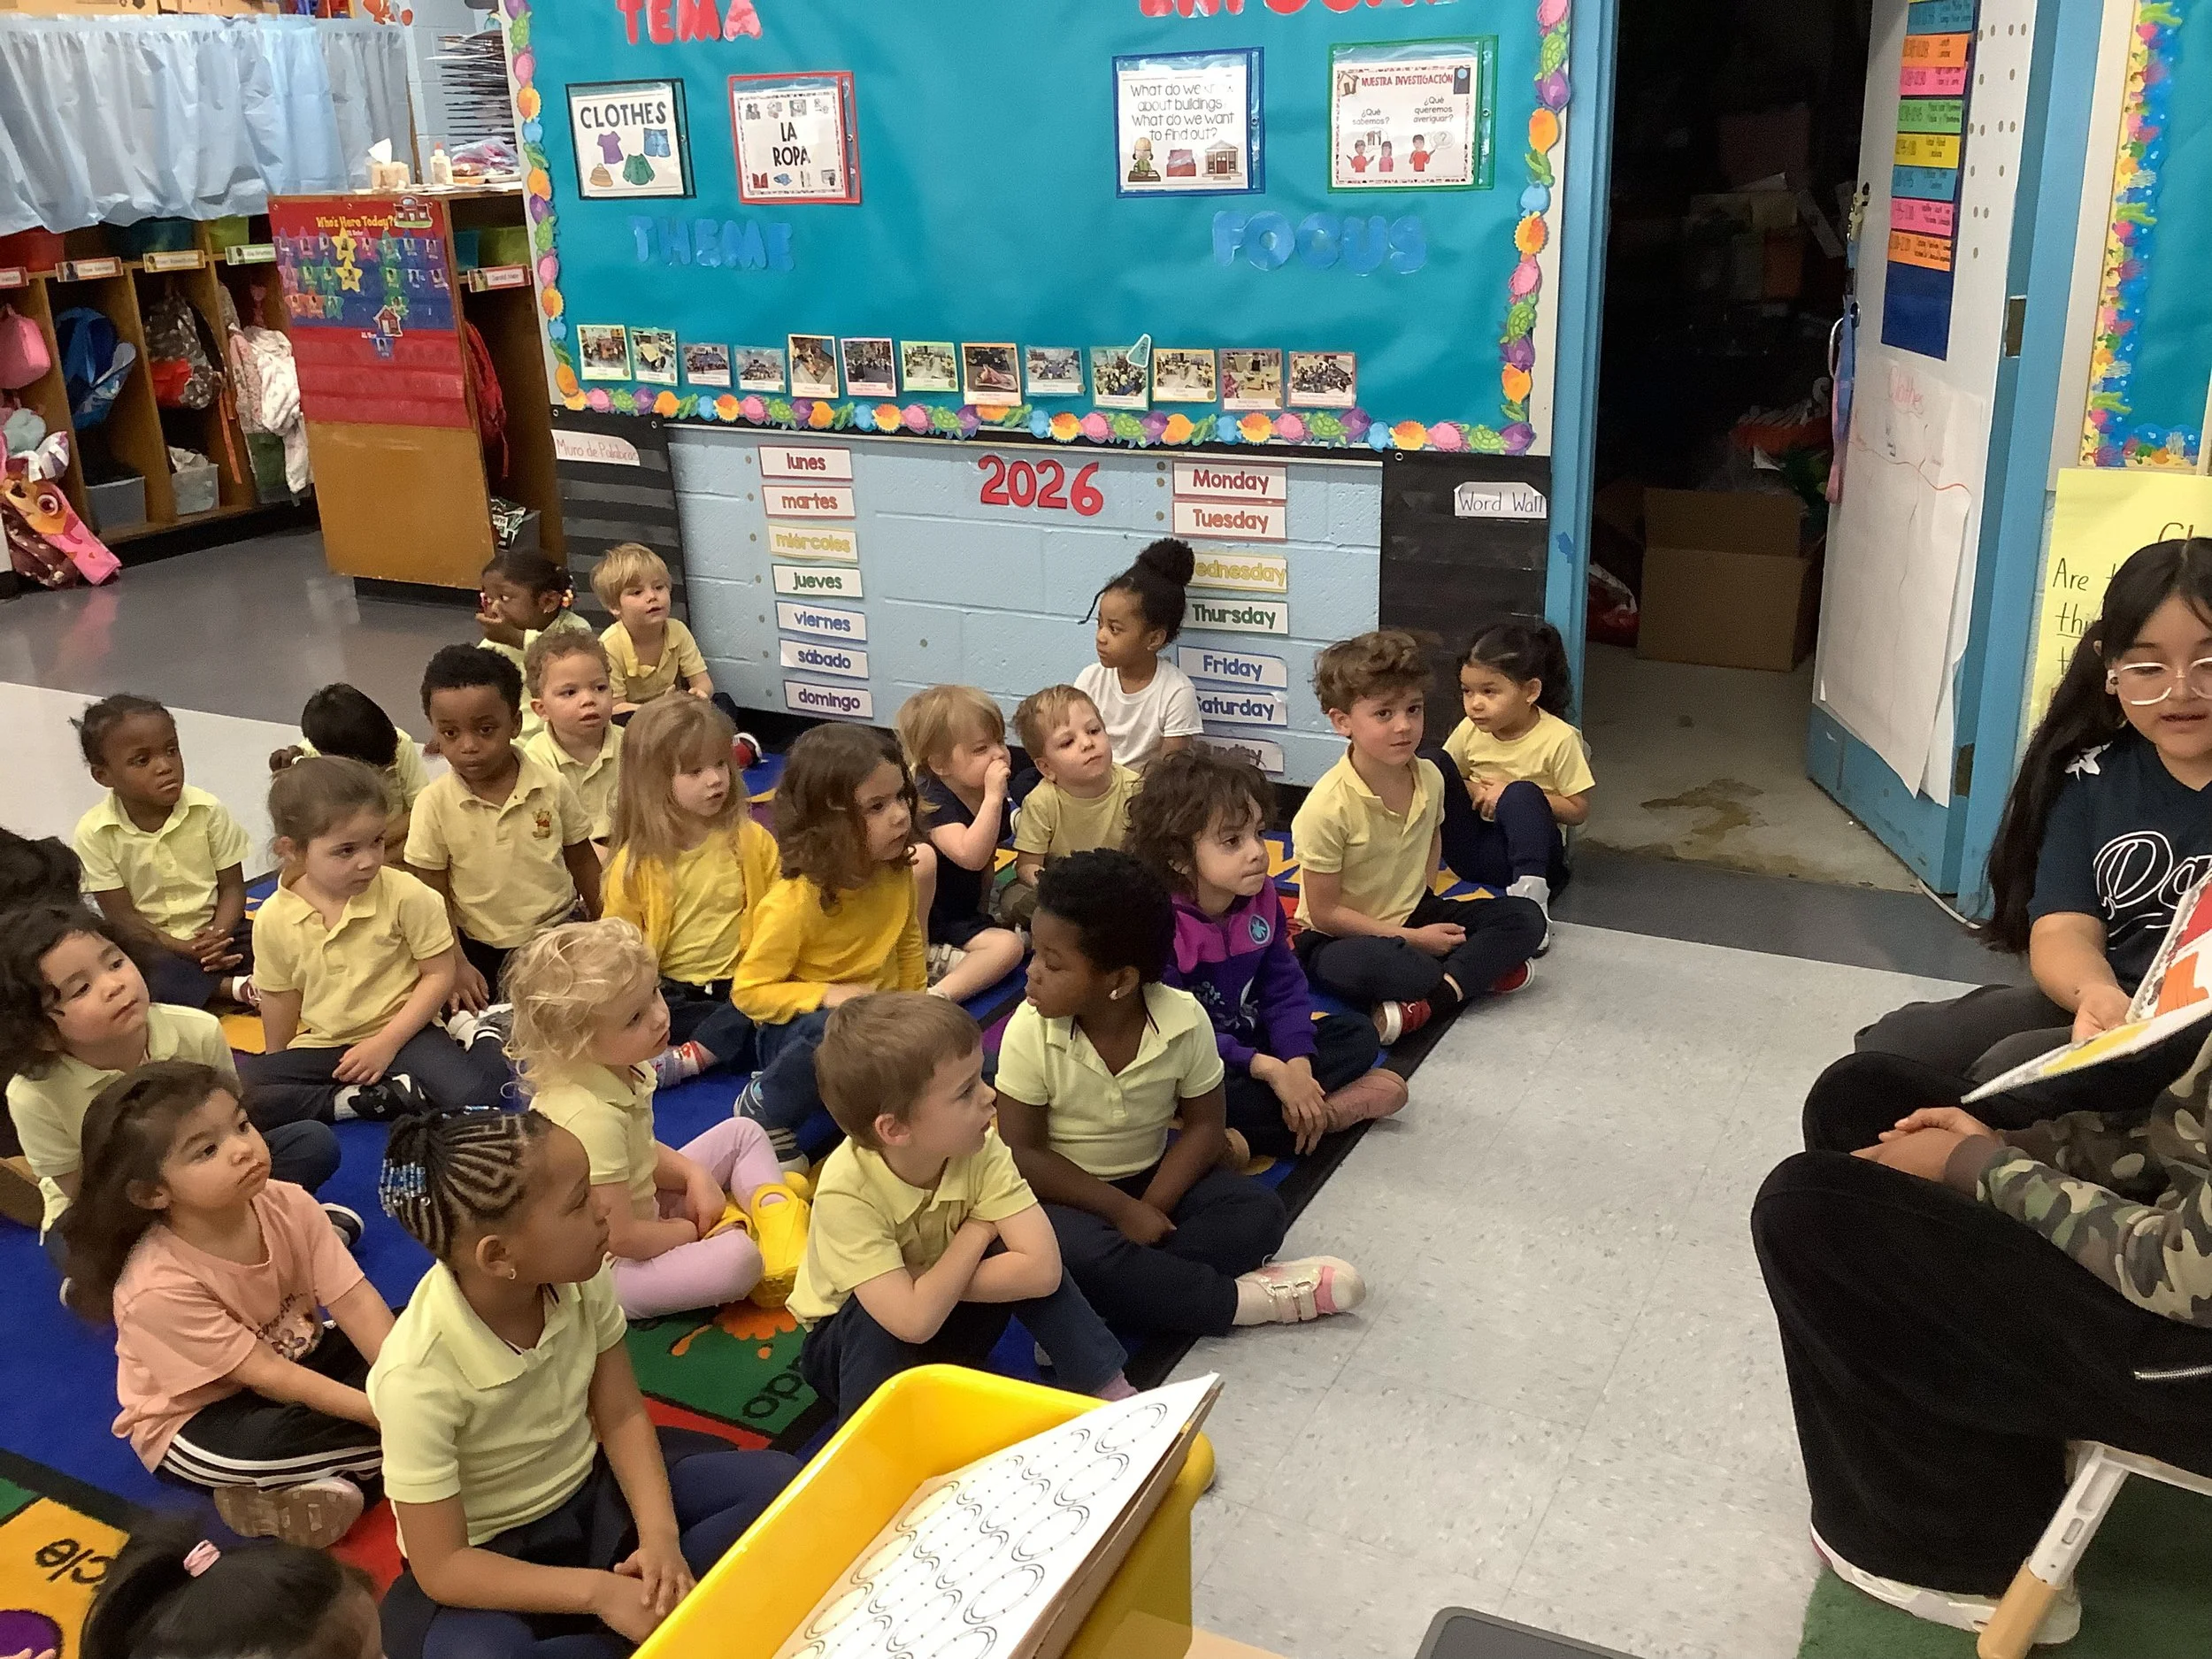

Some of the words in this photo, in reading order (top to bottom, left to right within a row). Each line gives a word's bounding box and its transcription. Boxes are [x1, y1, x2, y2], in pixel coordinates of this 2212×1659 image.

[615, 0, 763, 44] TEMA
[1130, 84, 1163, 96] What
[1165, 84, 1180, 96] do
[1183, 84, 1201, 95] we
[1362, 77, 1393, 87] NUESTRA
[1395, 73, 1454, 86] INVESTIGACIÓN
[1138, 99, 1172, 111] about
[1175, 98, 1223, 112] buildings
[1414, 105, 1453, 114] queremos
[1424, 96, 1444, 105] ¿Qué
[580, 101, 666, 129] CLOTHES
[1132, 114, 1164, 127] What
[1166, 113, 1181, 126] do
[1184, 114, 1202, 125] we
[1204, 111, 1234, 124] want
[1352, 117, 1390, 126] sabemos?
[1361, 108, 1381, 117] ¿Qué
[1413, 114, 1454, 124] averiguar?
[780, 122, 797, 142] LA
[1149, 129, 1162, 141] to
[1164, 128, 1187, 141] find
[1190, 127, 1217, 141] out?
[772, 146, 811, 166] ROPA
[316, 216, 338, 227] Who's
[361, 214, 394, 231] Today?
[628, 215, 795, 271] THEME
[1211, 210, 1428, 276] FOCUS
[556, 439, 584, 457] Muro
[587, 441, 597, 457] de
[787, 452, 826, 472] lunes
[978, 454, 1103, 517] 2026
[1193, 468, 1269, 495] Monday
[781, 492, 838, 511] martes
[1459, 491, 1502, 511] Word
[1512, 491, 1543, 512] Wall
[1193, 509, 1269, 534] Tuesday
[776, 531, 851, 554] miércoles
[792, 572, 842, 591] jueves
[1194, 559, 1286, 587] ednesday
[2053, 557, 2089, 591] Are
[794, 611, 851, 632] viernes
[1192, 603, 1276, 630] Thursday
[798, 649, 851, 670] sábado
[1202, 654, 1263, 682] Friday
[798, 688, 861, 711] domingo
